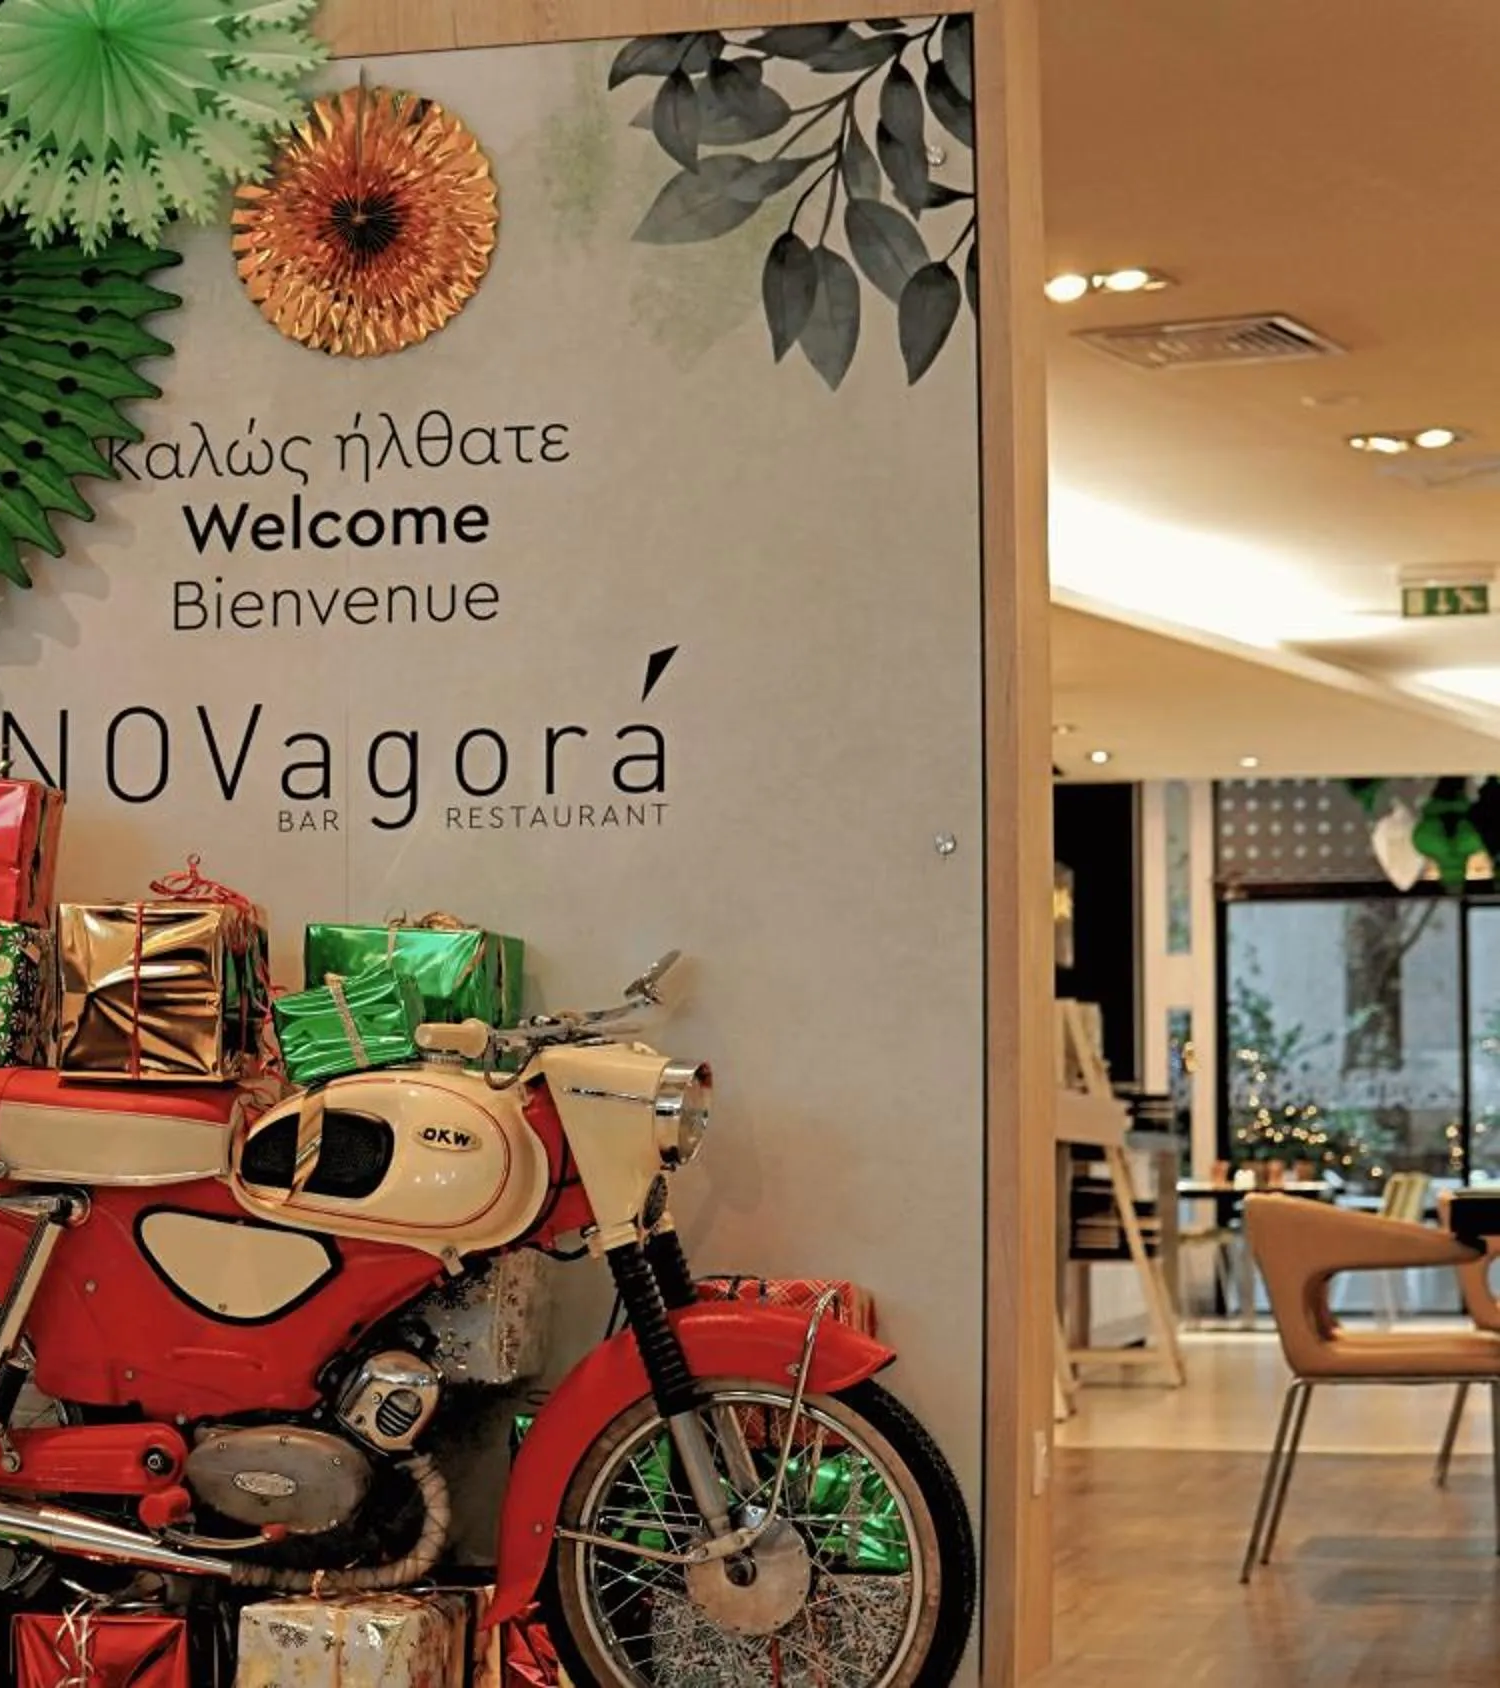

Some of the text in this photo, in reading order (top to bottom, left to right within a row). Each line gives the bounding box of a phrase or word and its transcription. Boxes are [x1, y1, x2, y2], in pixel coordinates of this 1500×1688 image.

[334, 409, 570, 483] ήλθατε
[182, 493, 490, 555] Welcome
[173, 575, 500, 631] Bienvenue
[278, 803, 669, 833] BAR RESTAURANT
